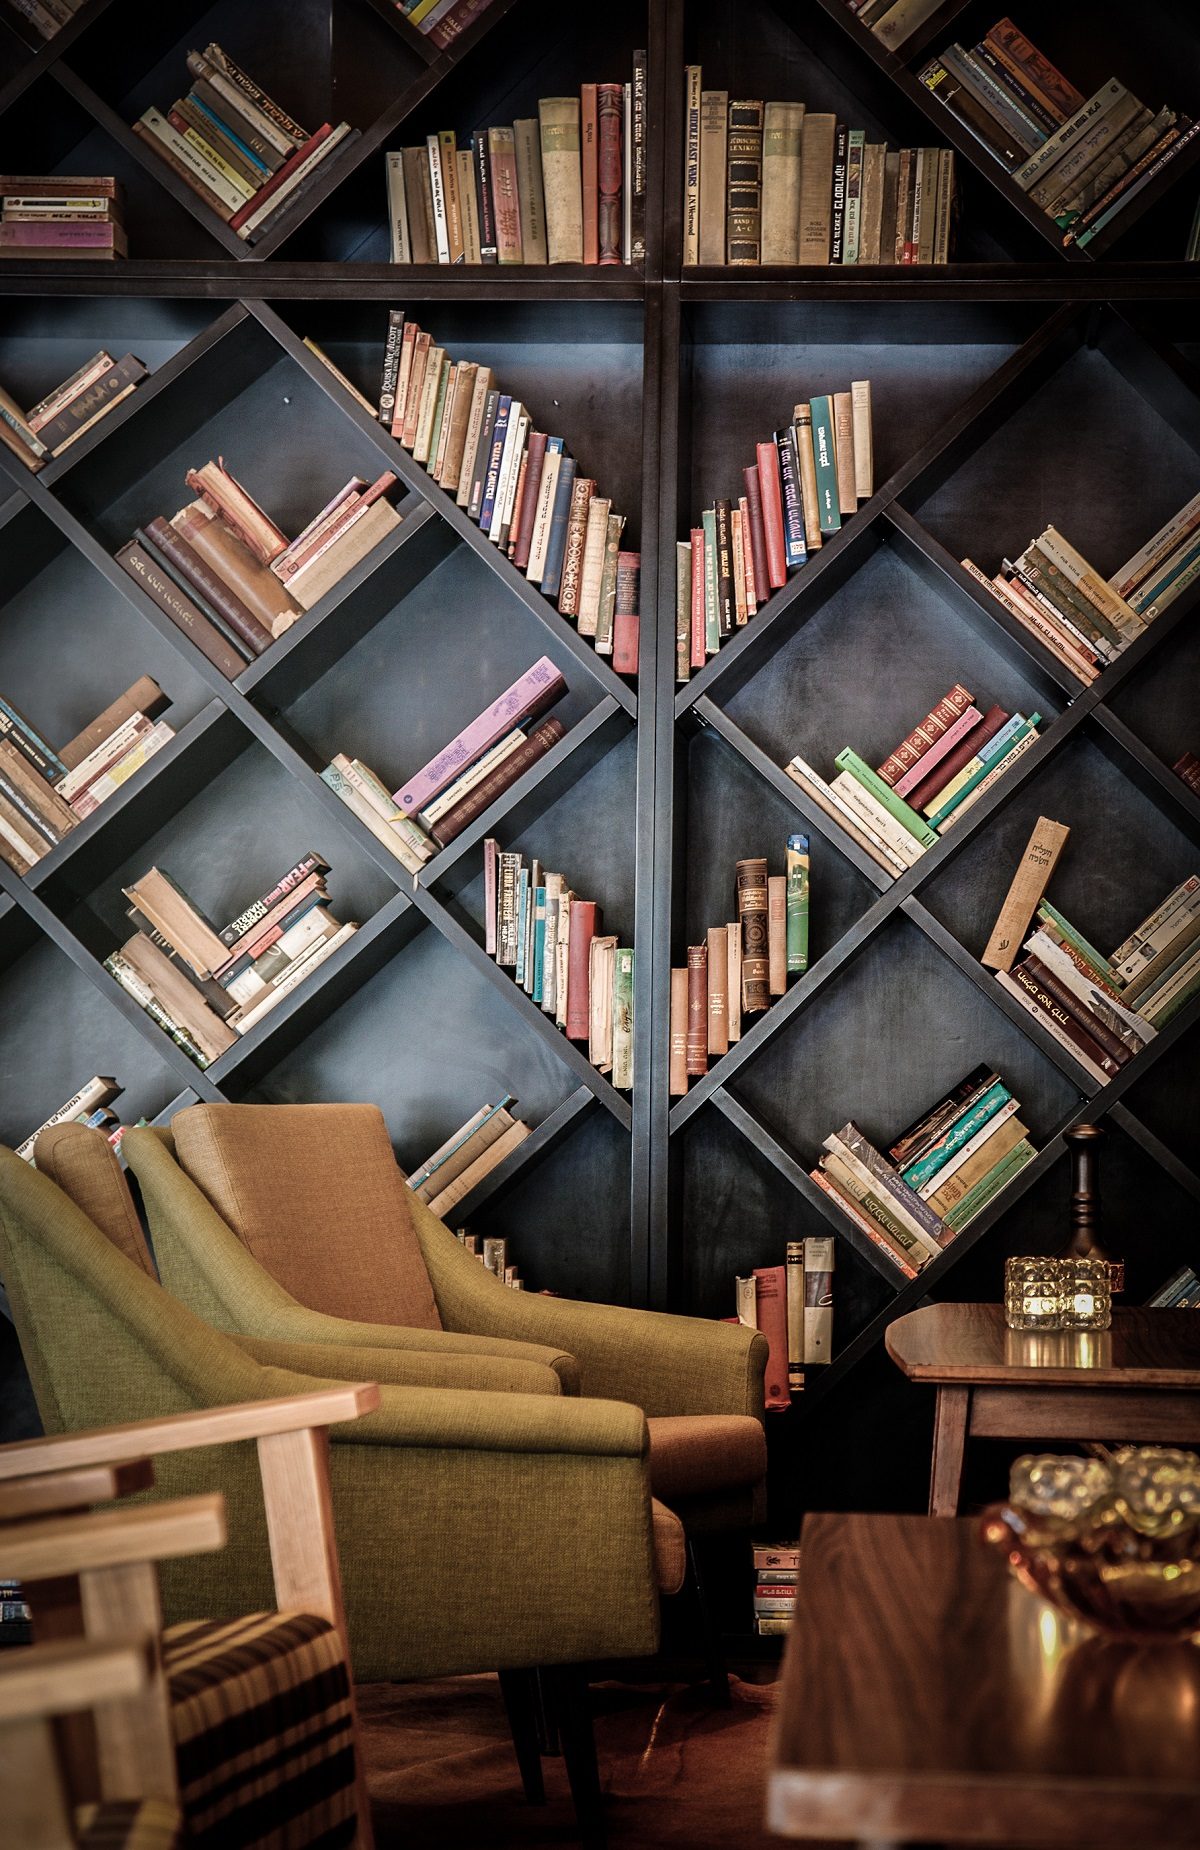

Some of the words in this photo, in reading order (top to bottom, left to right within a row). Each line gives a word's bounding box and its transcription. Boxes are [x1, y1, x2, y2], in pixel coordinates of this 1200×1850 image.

[634, 67, 642, 80] דרך
[634, 81, 642, 97] ארץ
[689, 108, 698, 139] MIDDLE
[688, 142, 697, 161] EAST
[688, 163, 697, 186] WARS
[832, 164, 846, 209] פרסטרויקה
[687, 204, 695, 235] Westwood
[832, 239, 840, 257] מיכאל
[385, 325, 398, 351] ALCOTT
[383, 352, 395, 368] MAY
[378, 368, 393, 391] LOUISA
[489, 440, 503, 469] בחזרה
[778, 448, 792, 466] תמי
[483, 469, 497, 499] לאהבה
[781, 466, 792, 480] הוג
[783, 482, 800, 508] במבחן
[785, 508, 802, 539] הרגשות
[303, 857, 315, 868] THE
[275, 862, 310, 893] FEAR
[502, 868, 514, 888] LINDA
[261, 886, 283, 906] INDEX
[228, 899, 264, 930] HARRIS
[233, 905, 269, 936] ROBERT
[507, 923, 515, 946] KILLER
[1015, 971, 1038, 994] חיילים
[1036, 991, 1053, 1009] יצאו
[1048, 1004, 1071, 1026] לדרך
[1038, 1013, 1053, 1028] ЖУРНАЛ
[48, 1094, 83, 1124] המשולש
[844, 1177, 865, 1198] תורת
[861, 1197, 888, 1225] הכלכלה
[883, 1220, 910, 1248] המדינית
